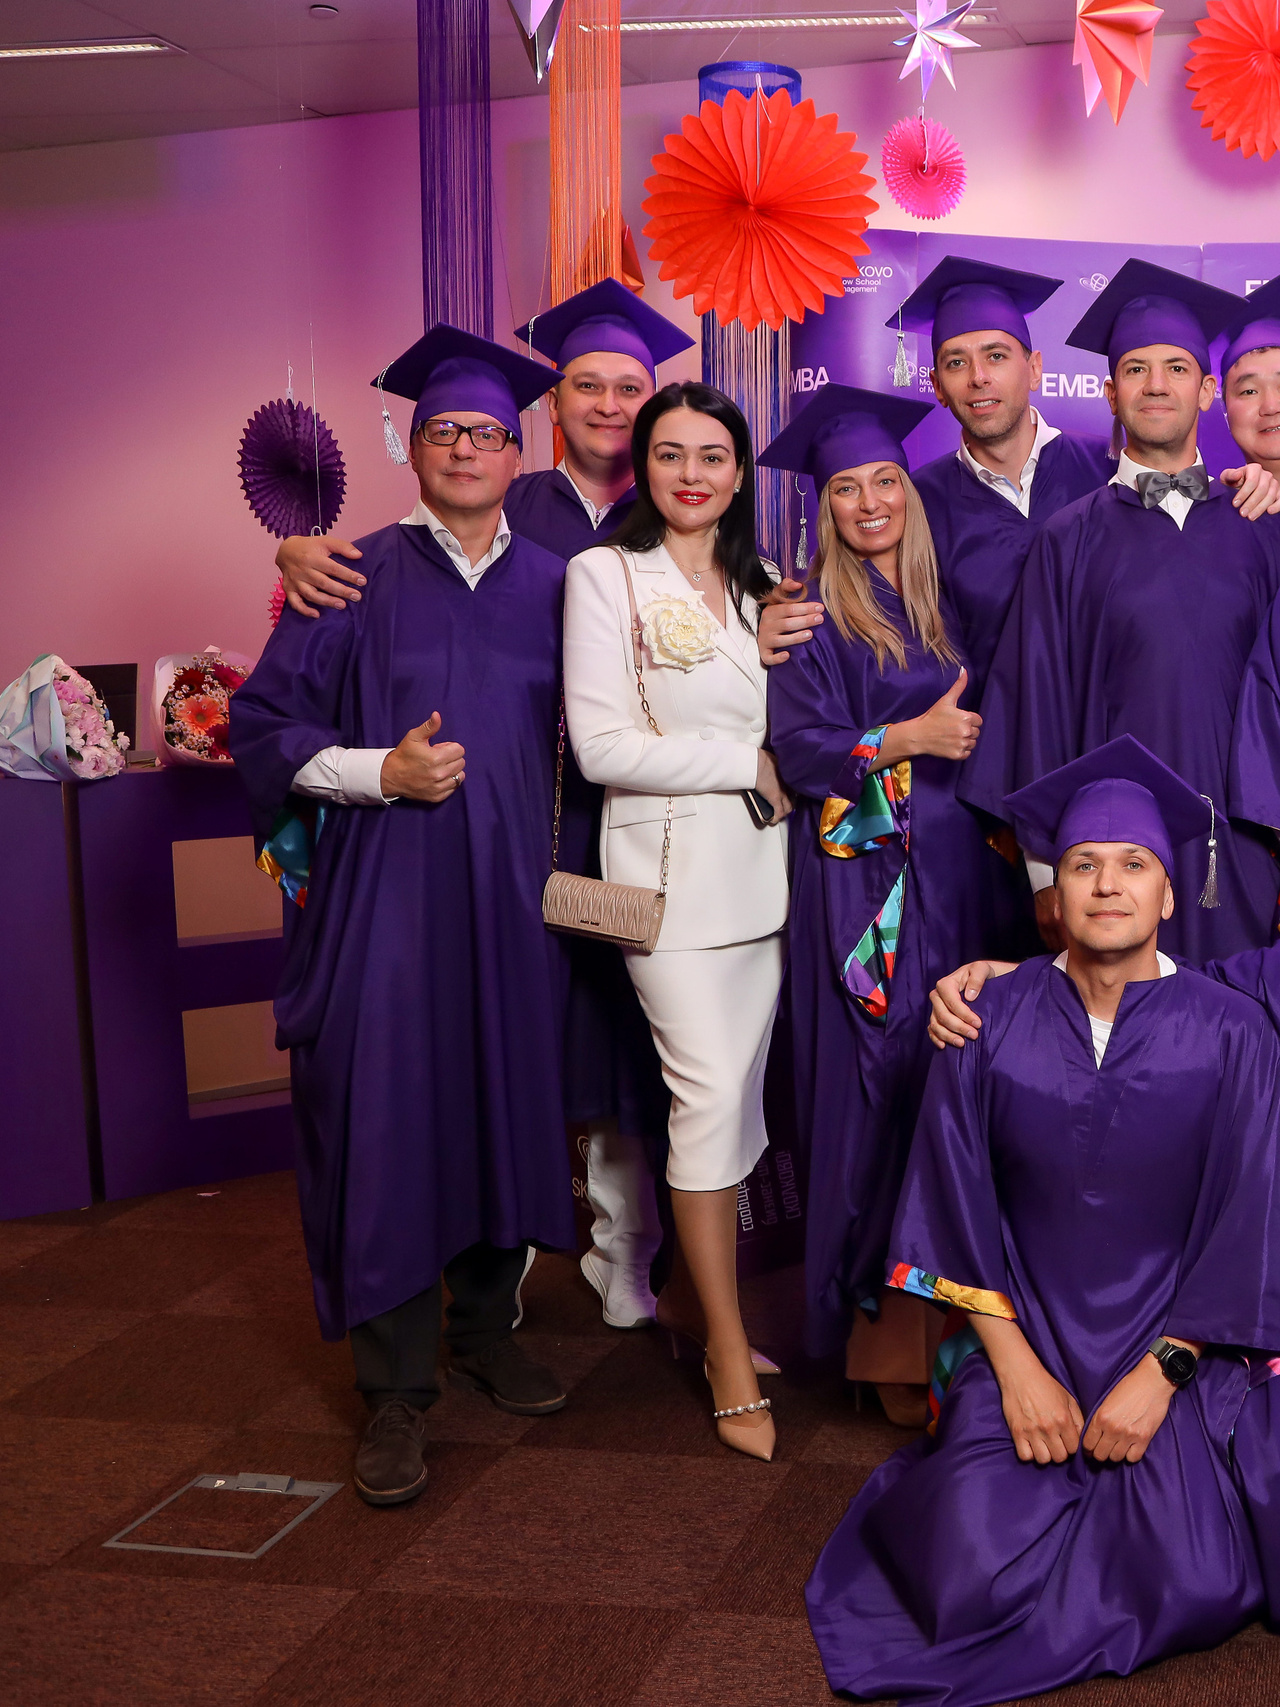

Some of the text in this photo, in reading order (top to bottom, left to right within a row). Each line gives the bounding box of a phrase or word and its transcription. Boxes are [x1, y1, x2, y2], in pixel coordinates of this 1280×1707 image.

[855, 277, 882, 285] School
[857, 265, 893, 278] KOVO
[844, 285, 877, 294] nagement
[790, 366, 830, 395] MBA
[757, 1152, 778, 1226] бизнес-шк
[737, 1179, 754, 1231] сообще
